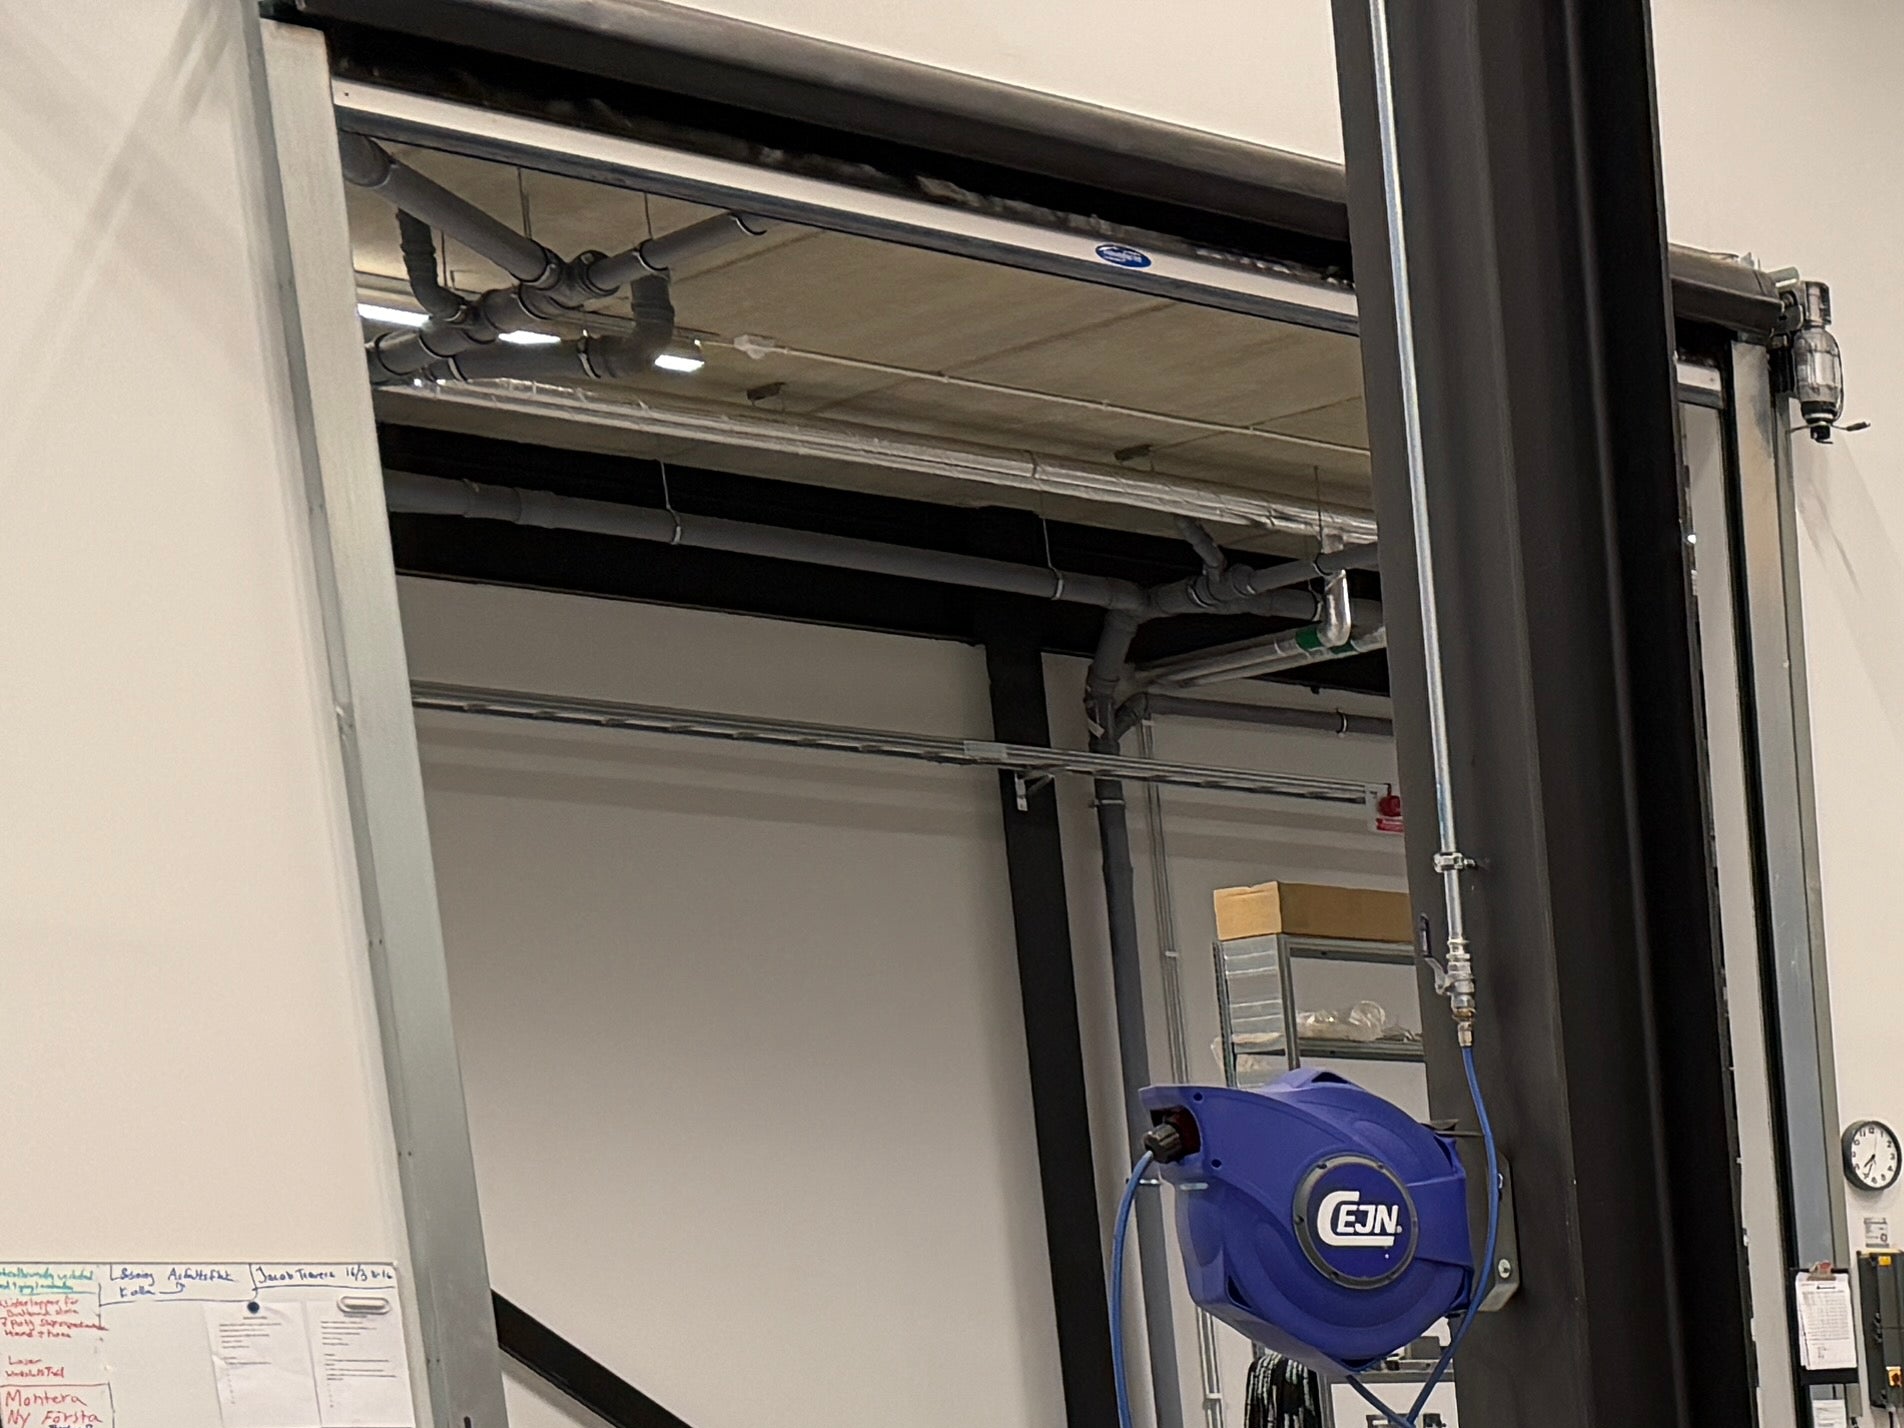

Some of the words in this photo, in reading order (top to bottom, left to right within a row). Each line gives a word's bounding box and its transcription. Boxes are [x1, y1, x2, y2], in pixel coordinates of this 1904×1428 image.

[1317, 1190, 1399, 1247] CEJN
[5, 1389, 88, 1407] Montera
[41, 1410, 103, 1425] Första
